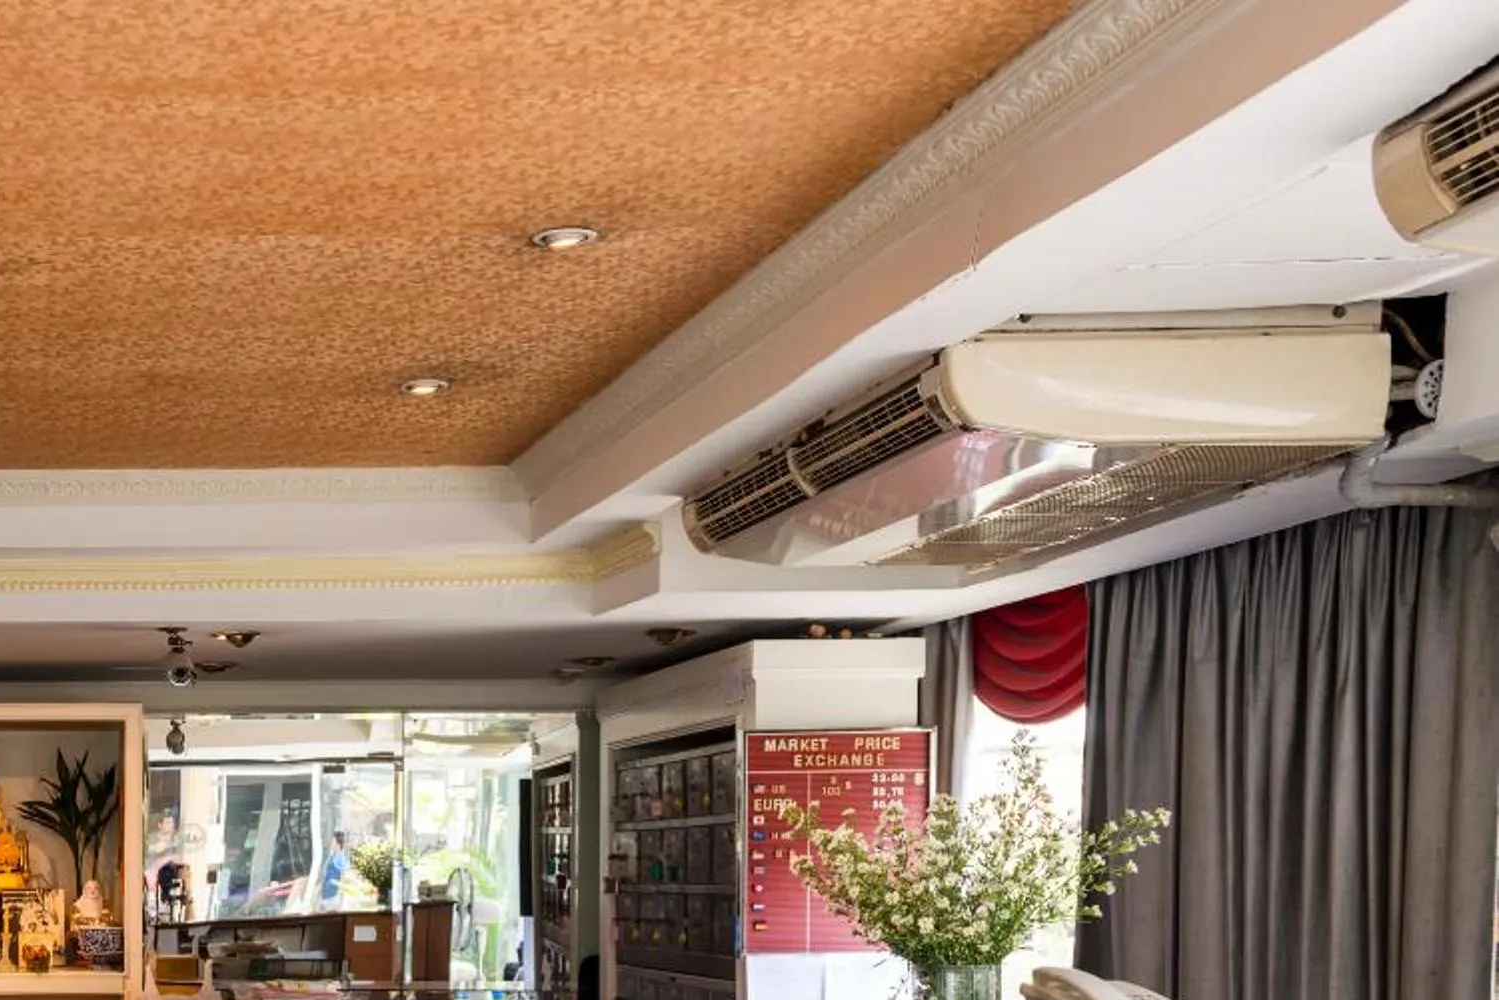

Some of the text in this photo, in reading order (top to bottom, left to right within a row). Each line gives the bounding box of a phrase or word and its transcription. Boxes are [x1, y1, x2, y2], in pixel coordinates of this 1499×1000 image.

[764, 736, 901, 752] MARKET PRICE
[793, 753, 885, 767] EXCHANGE
